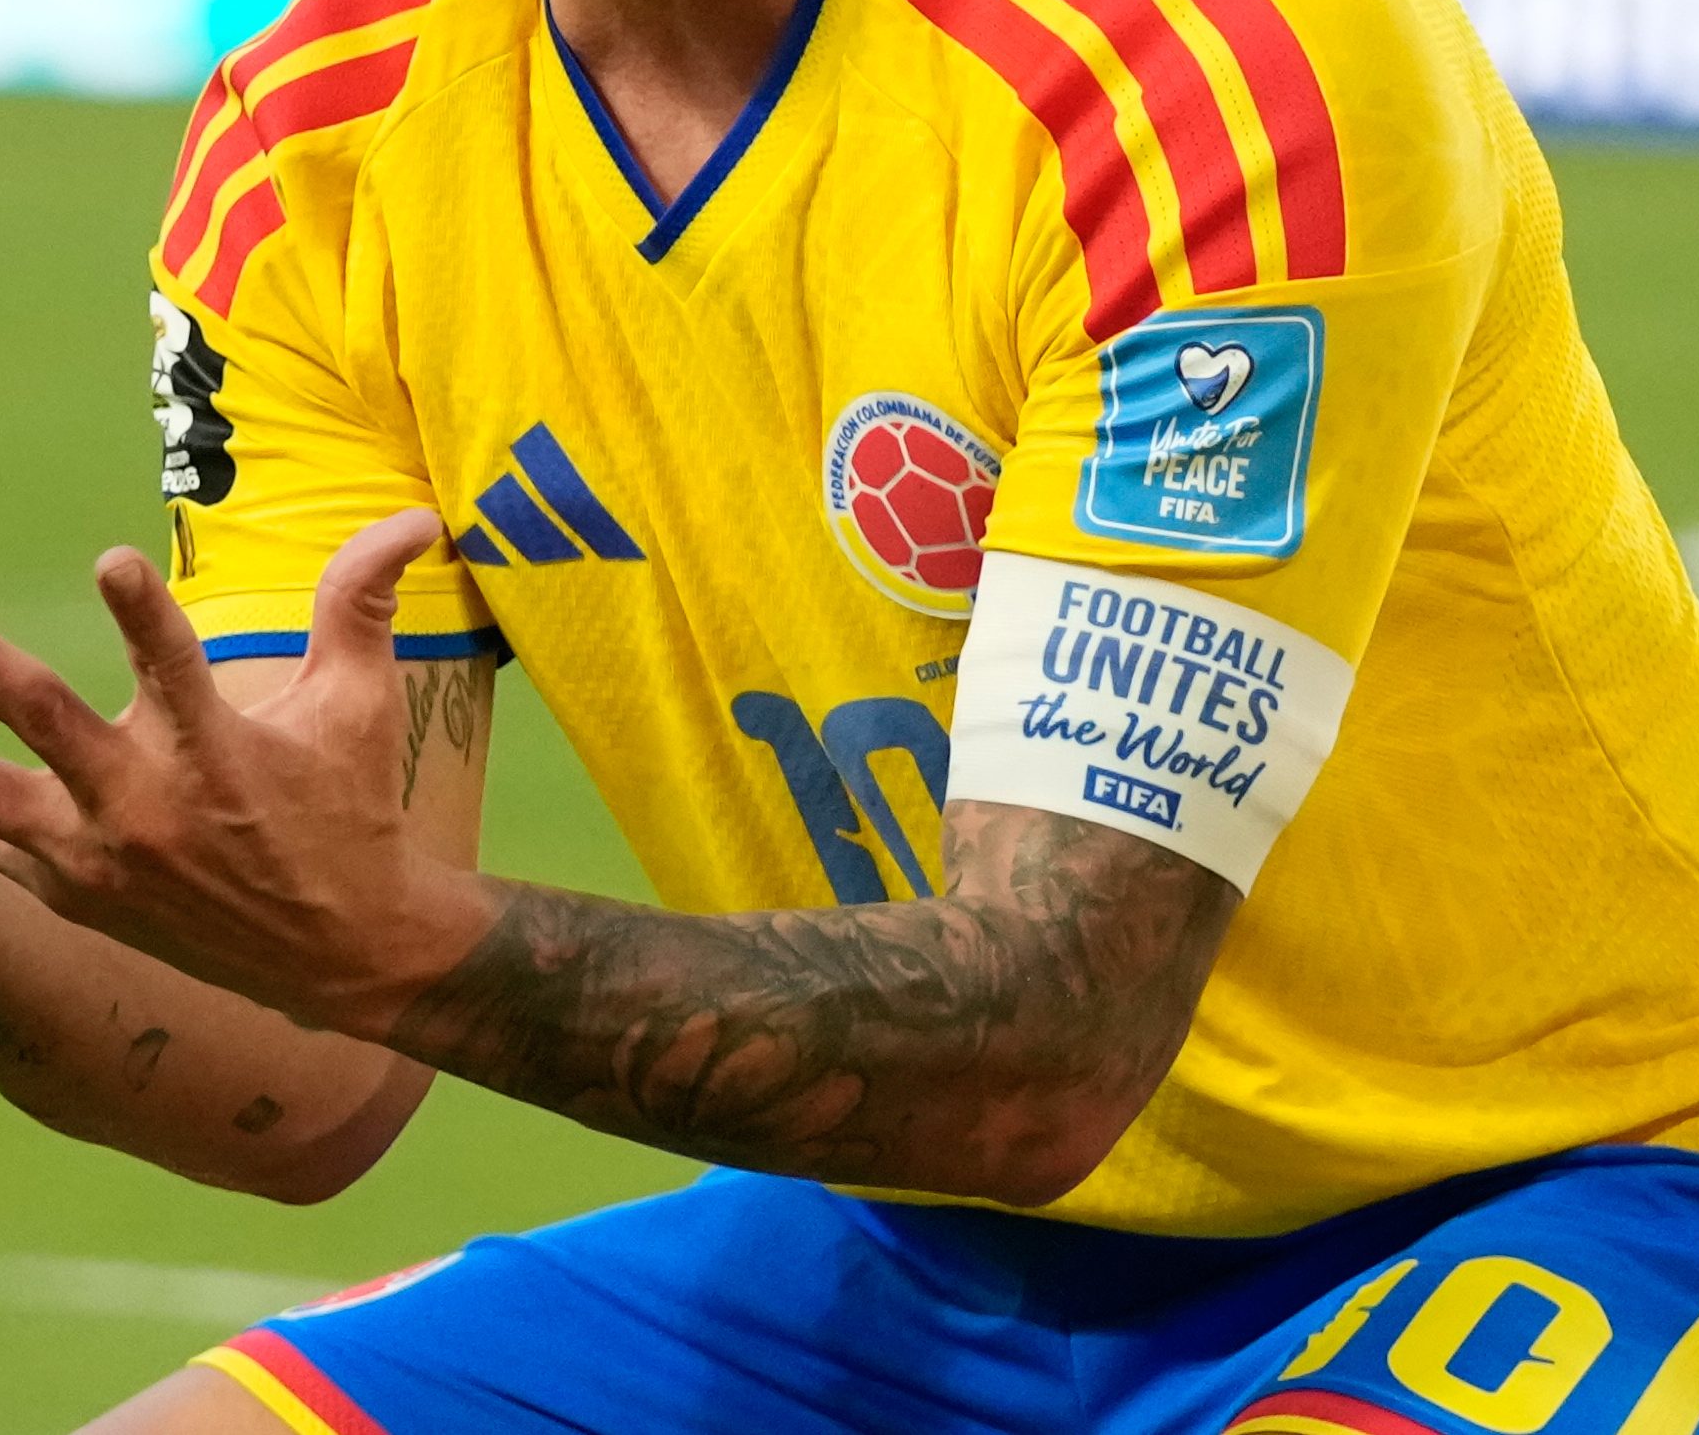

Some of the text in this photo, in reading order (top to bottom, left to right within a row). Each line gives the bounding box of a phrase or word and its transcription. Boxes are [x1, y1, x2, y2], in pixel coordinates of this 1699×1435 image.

[856, 400, 942, 431] COLOMBIANA
[945, 424, 965, 445] DE
[1150, 415, 1262, 453] Unite For
[1142, 451, 1250, 499] PEACE
[1158, 496, 1217, 524] FIFA
[1057, 580, 1286, 691] FOOTBALL
[1041, 625, 1280, 746] UNITES
[1017, 691, 1267, 809] the World
[1090, 772, 1172, 821] FIFA
